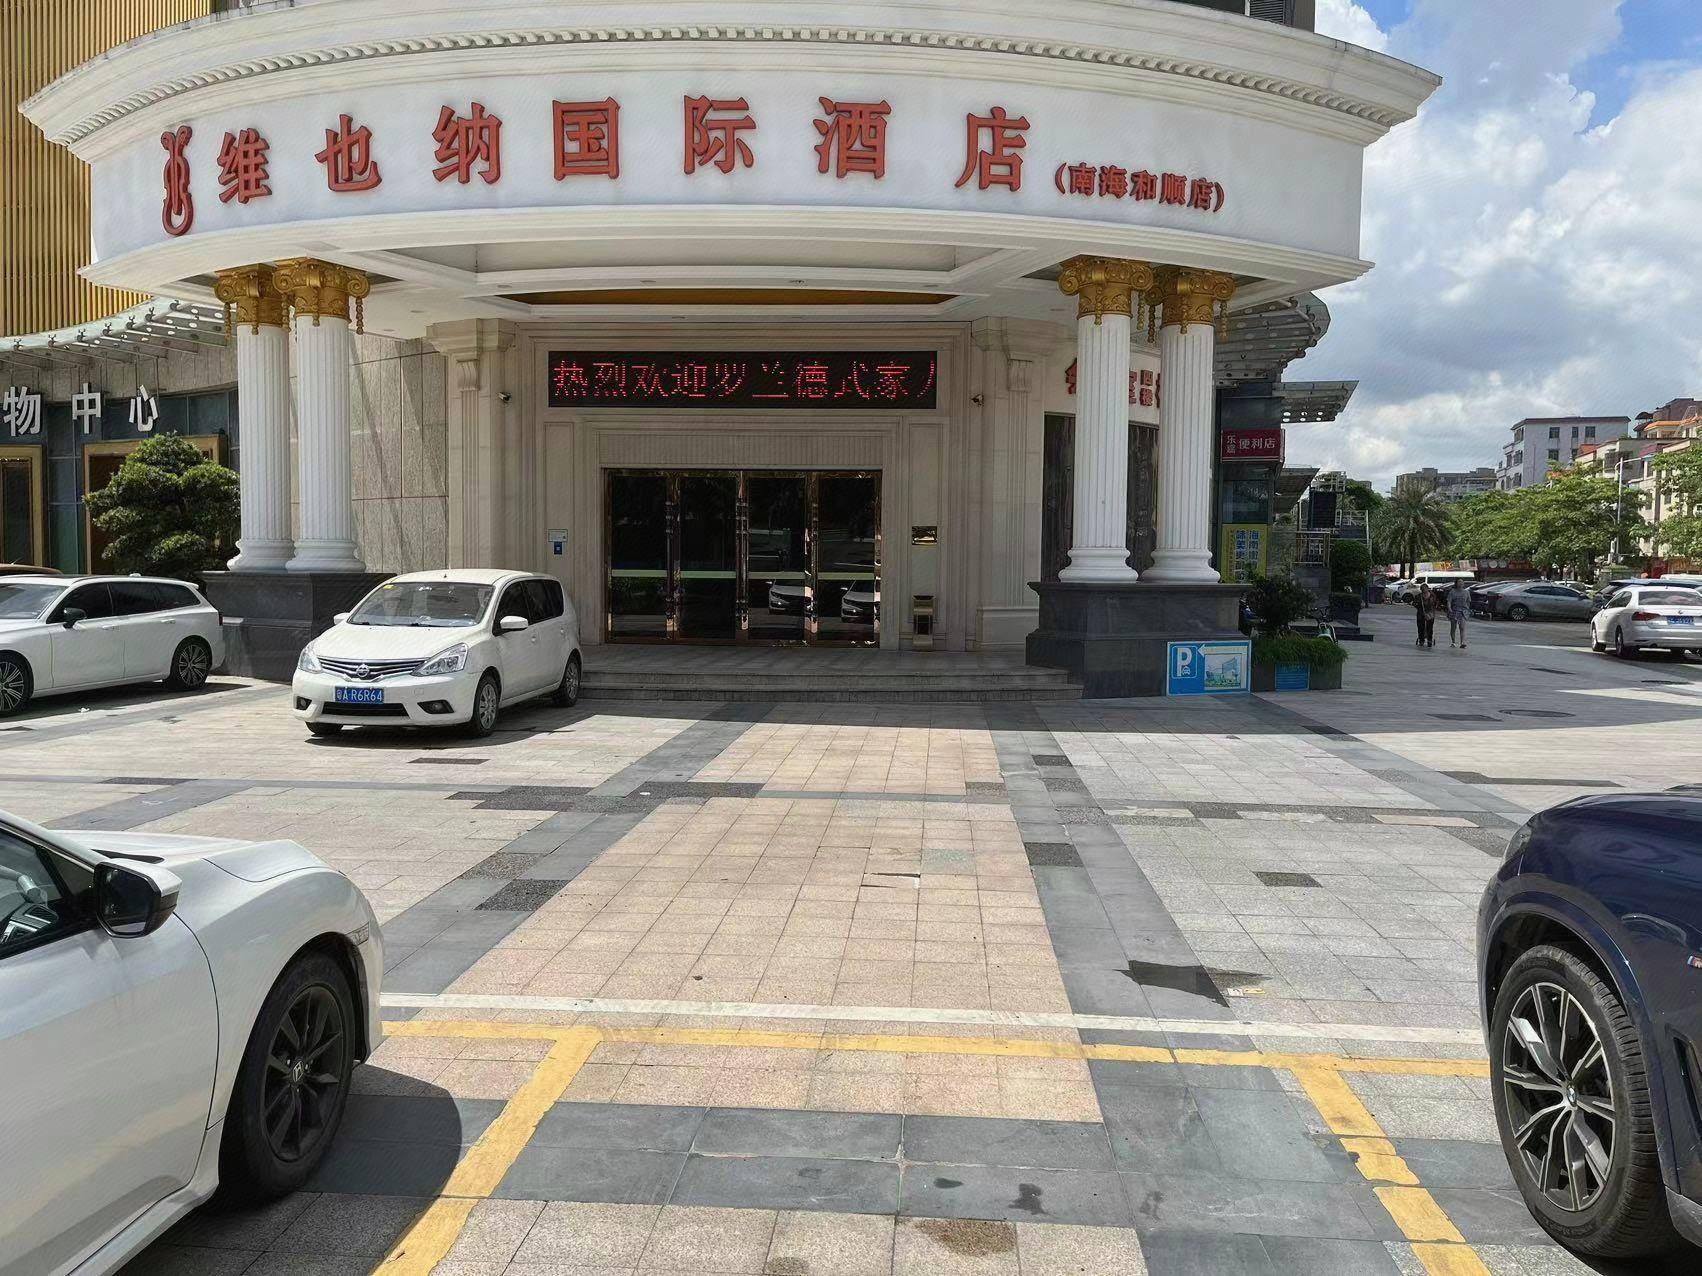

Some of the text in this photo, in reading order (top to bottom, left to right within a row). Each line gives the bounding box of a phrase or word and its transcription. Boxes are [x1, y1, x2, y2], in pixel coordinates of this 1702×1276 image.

[217, 96, 1031, 204] 维也纳国际酒店
[1239, 437, 1276, 450] 便利店
[1177, 648, 1192, 677] P
